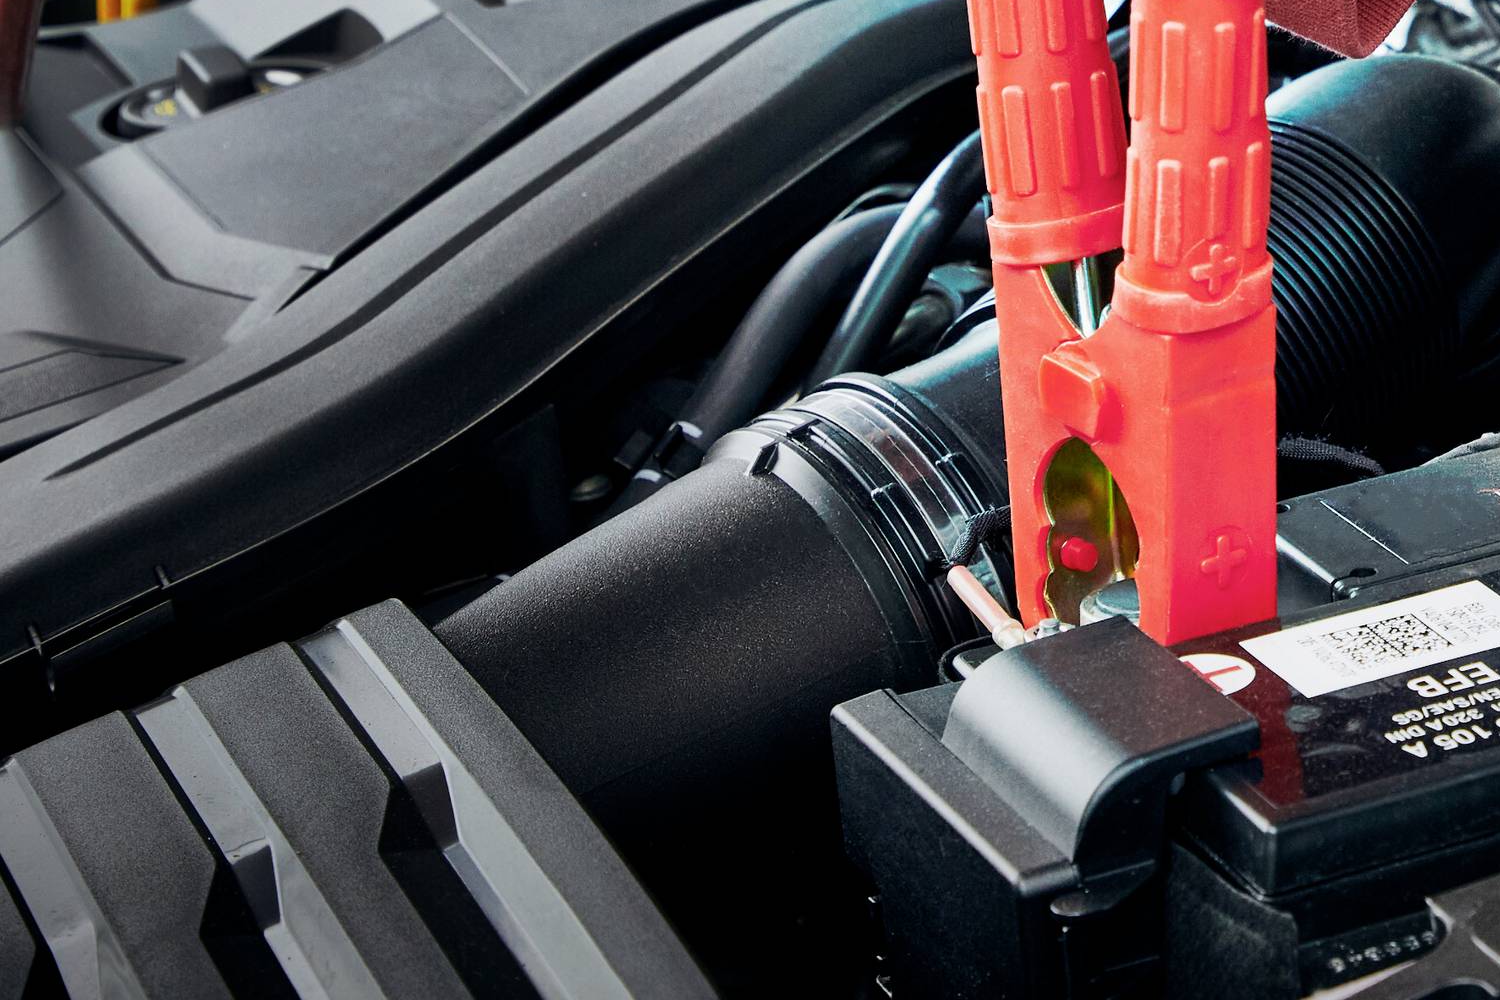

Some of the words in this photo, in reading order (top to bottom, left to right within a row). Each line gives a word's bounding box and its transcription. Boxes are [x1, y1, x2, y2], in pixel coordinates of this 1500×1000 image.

[1407, 662, 1500, 697] EFB
[1425, 708, 1483, 730] 320A
[1384, 725, 1425, 743] DIN
[1433, 725, 1491, 749] 105
[1401, 741, 1427, 757] A
